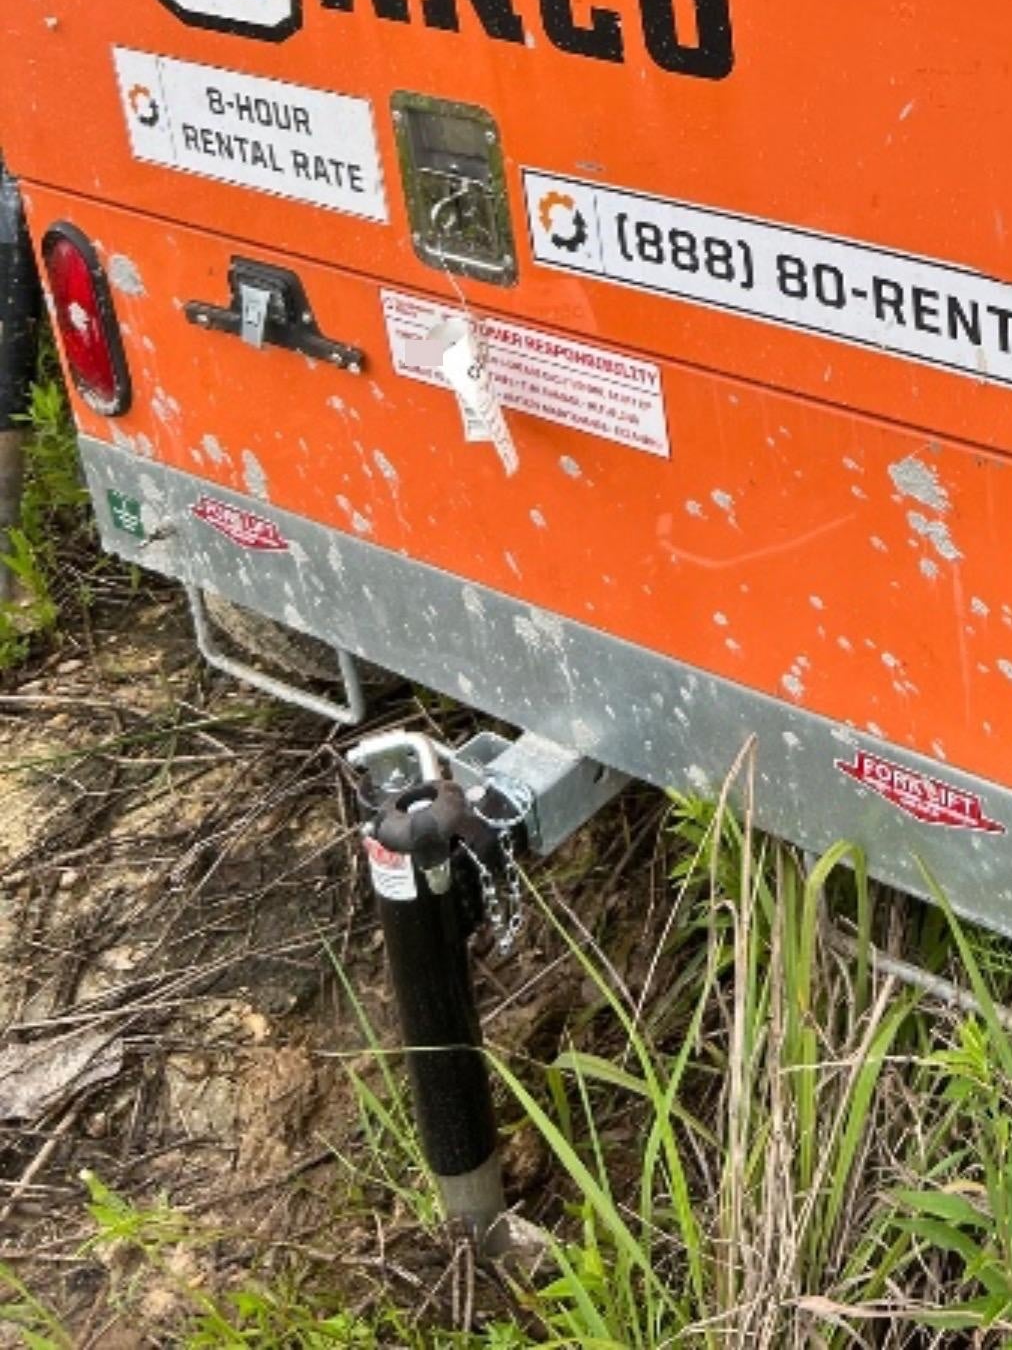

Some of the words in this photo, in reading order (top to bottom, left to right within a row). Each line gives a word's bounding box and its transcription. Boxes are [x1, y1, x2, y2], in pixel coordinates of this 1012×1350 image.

[206, 86, 312, 135] 8-HOUR
[182, 122, 284, 174] RENTAL
[291, 149, 365, 193] RATE
[615, 212, 754, 289] (888)
